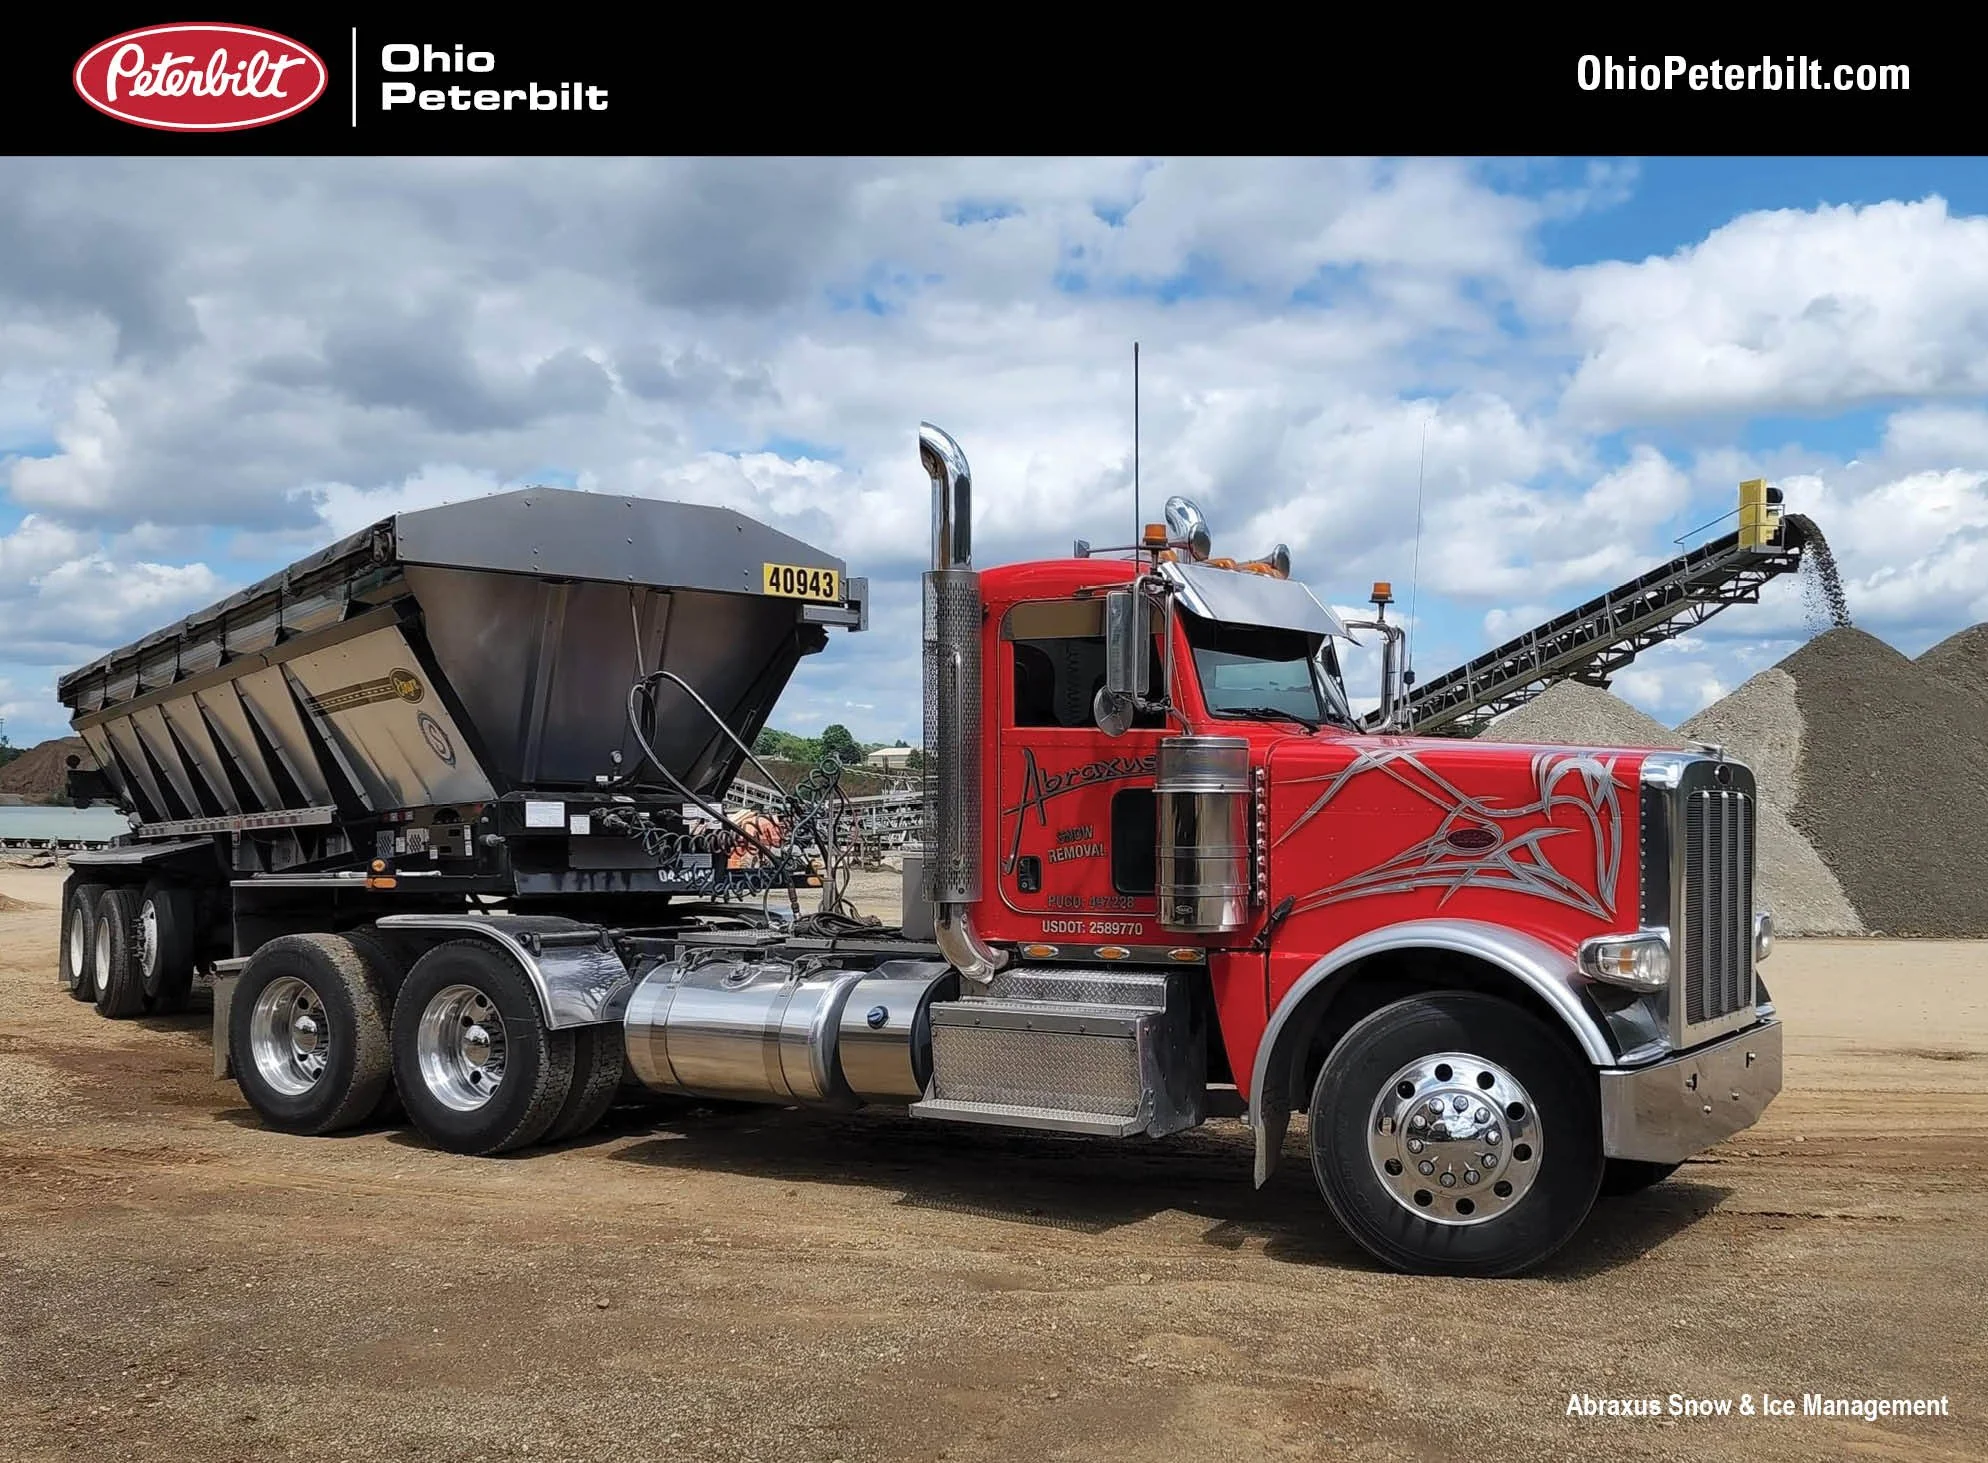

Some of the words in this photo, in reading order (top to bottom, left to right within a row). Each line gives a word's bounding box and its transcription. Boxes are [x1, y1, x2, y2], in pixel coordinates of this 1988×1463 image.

[769, 566, 834, 598] 40943
[1042, 920, 1086, 934] USDOT:
[1089, 921, 1143, 935] 2589770
